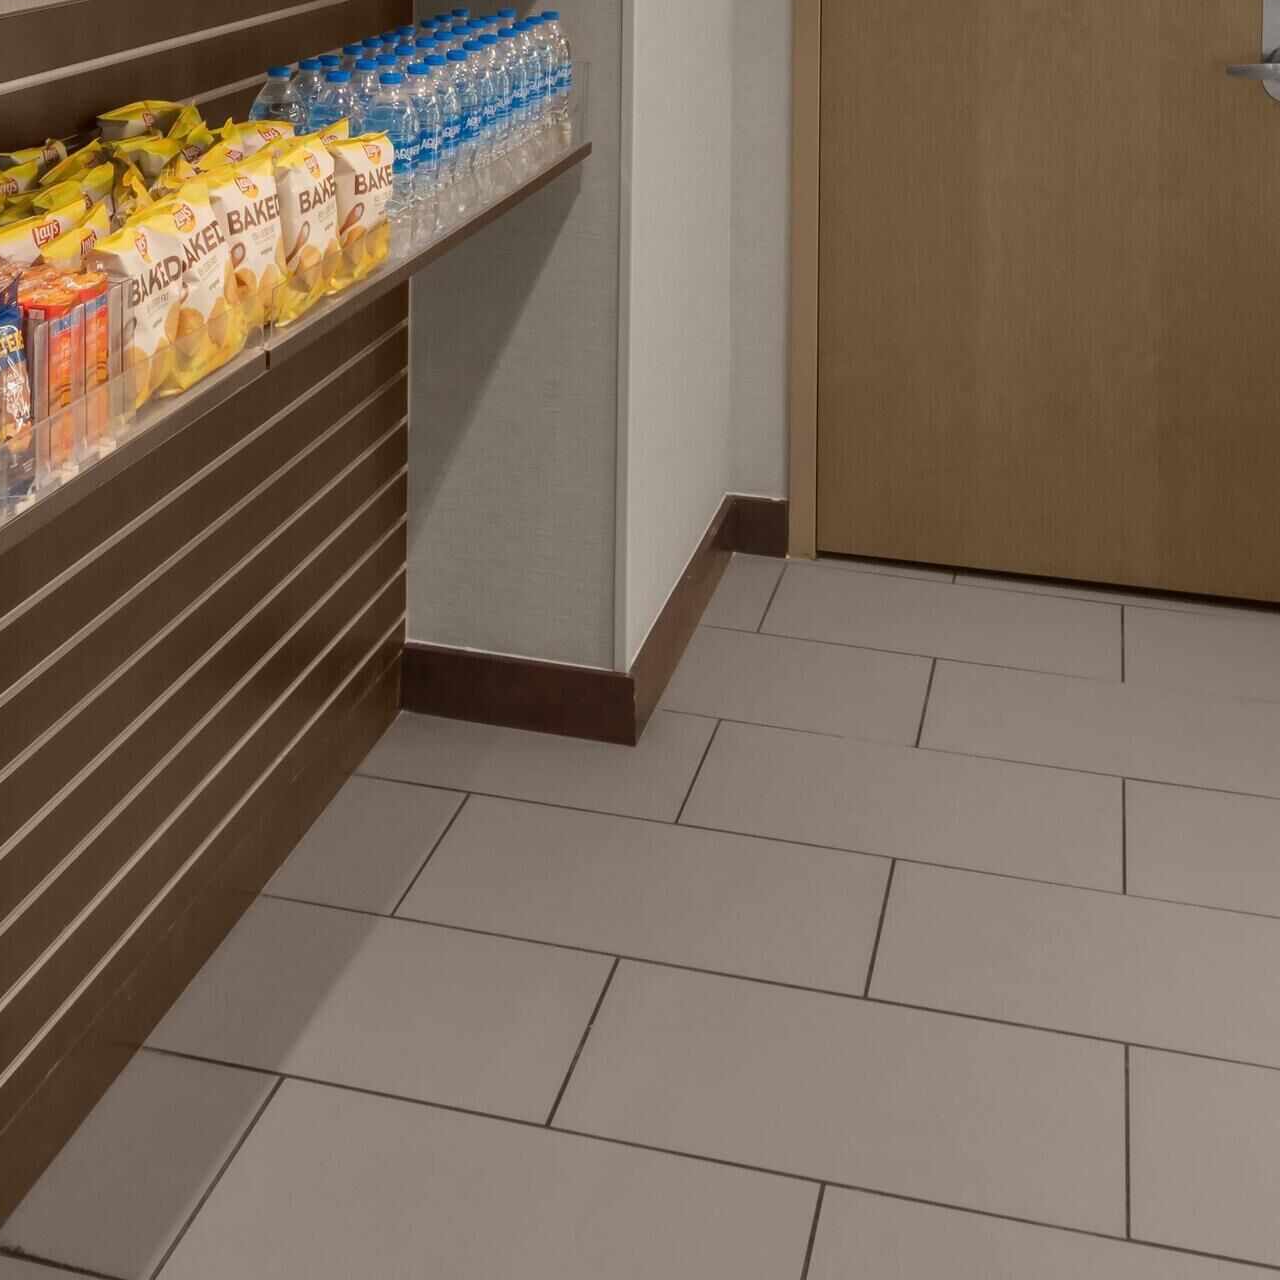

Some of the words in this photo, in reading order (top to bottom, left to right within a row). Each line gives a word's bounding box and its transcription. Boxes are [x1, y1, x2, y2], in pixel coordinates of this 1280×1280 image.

[299, 173, 336, 214] BAKE
[354, 164, 392, 195] BAKE
[35, 222, 59, 245] Lay's
[227, 192, 281, 236] BAKED
[181, 219, 225, 268] AKED
[129, 254, 185, 307] BAKED
